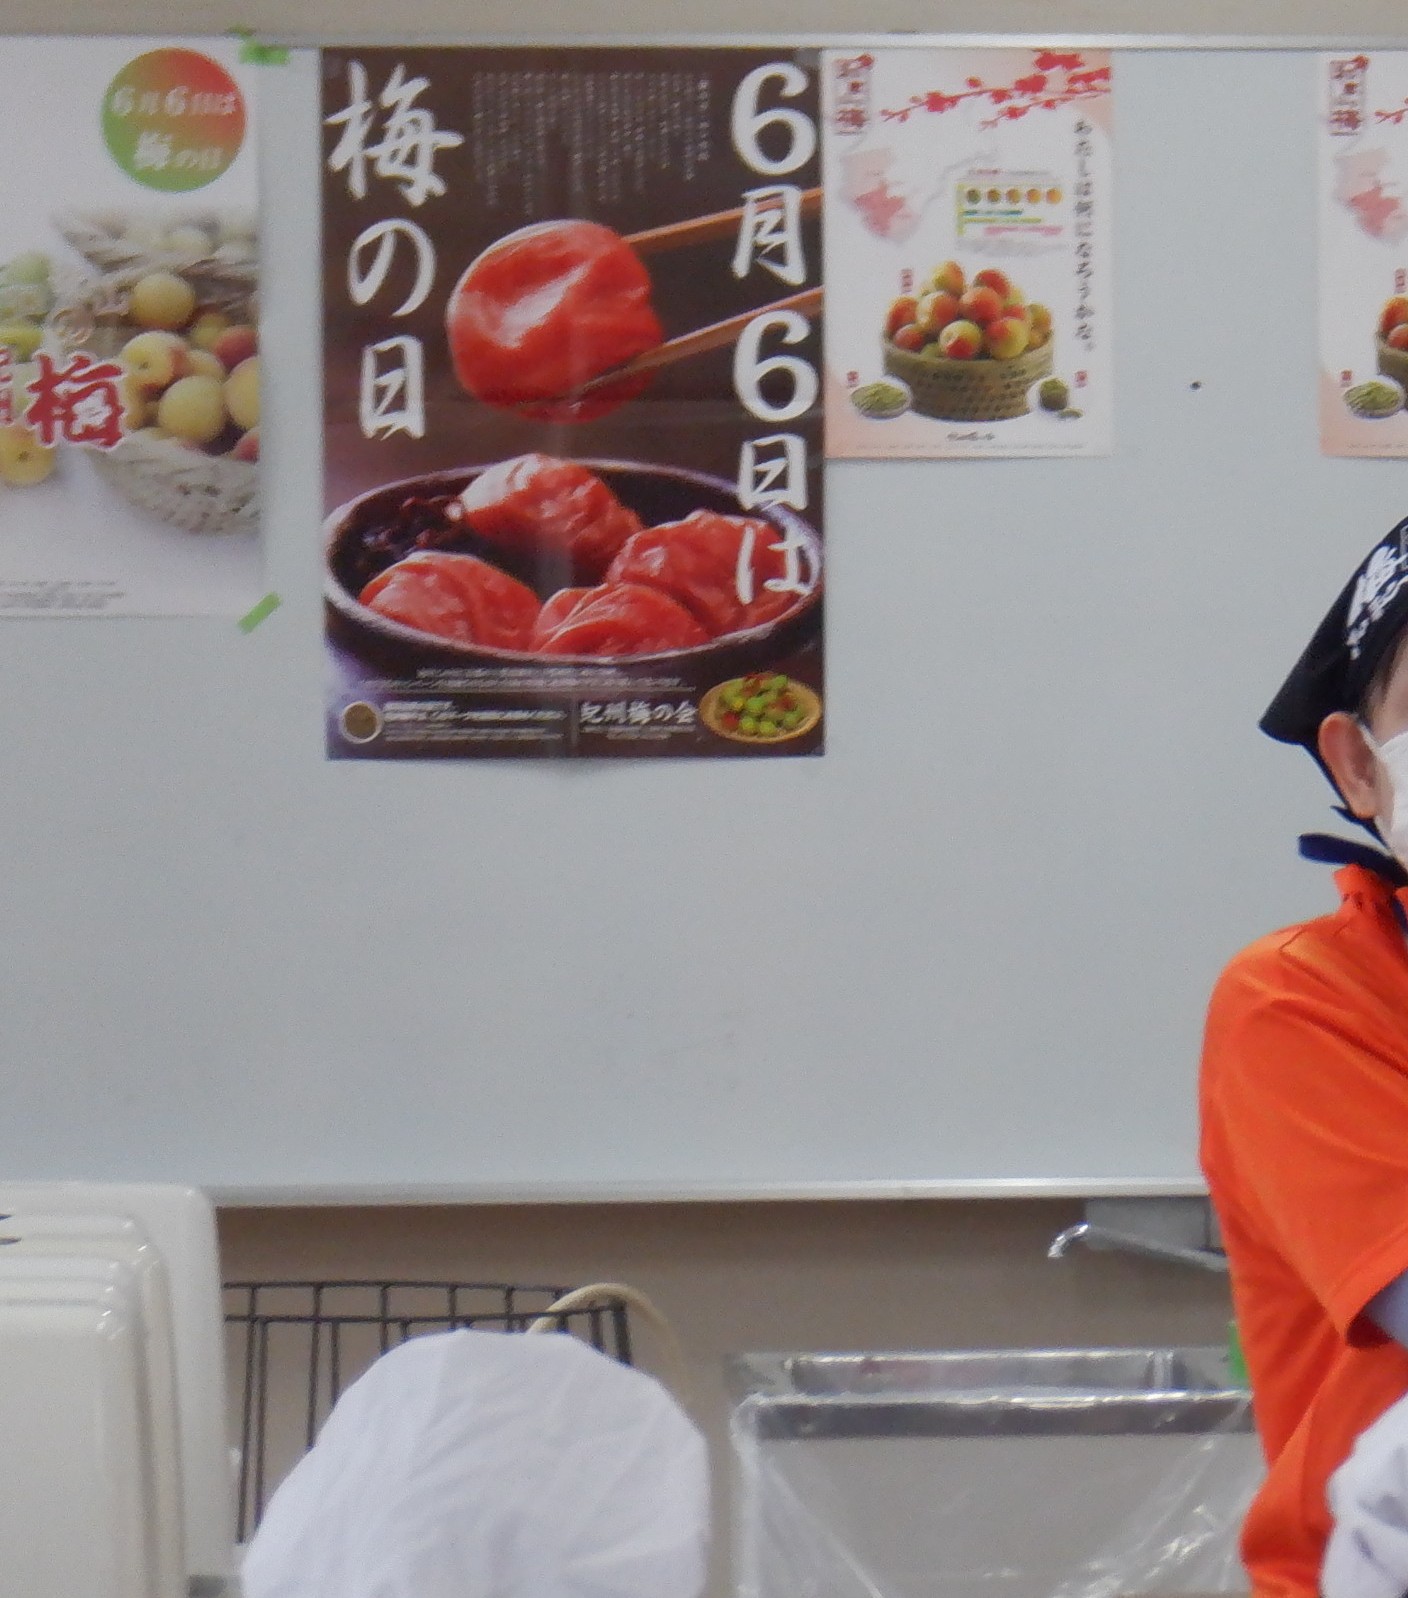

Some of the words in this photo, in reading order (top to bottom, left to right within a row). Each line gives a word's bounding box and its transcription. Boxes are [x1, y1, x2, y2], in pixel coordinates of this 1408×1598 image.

[26, 351, 125, 450] 梅
[325, 62, 466, 440] 梅の日
[730, 60, 821, 604] 6月6日は
